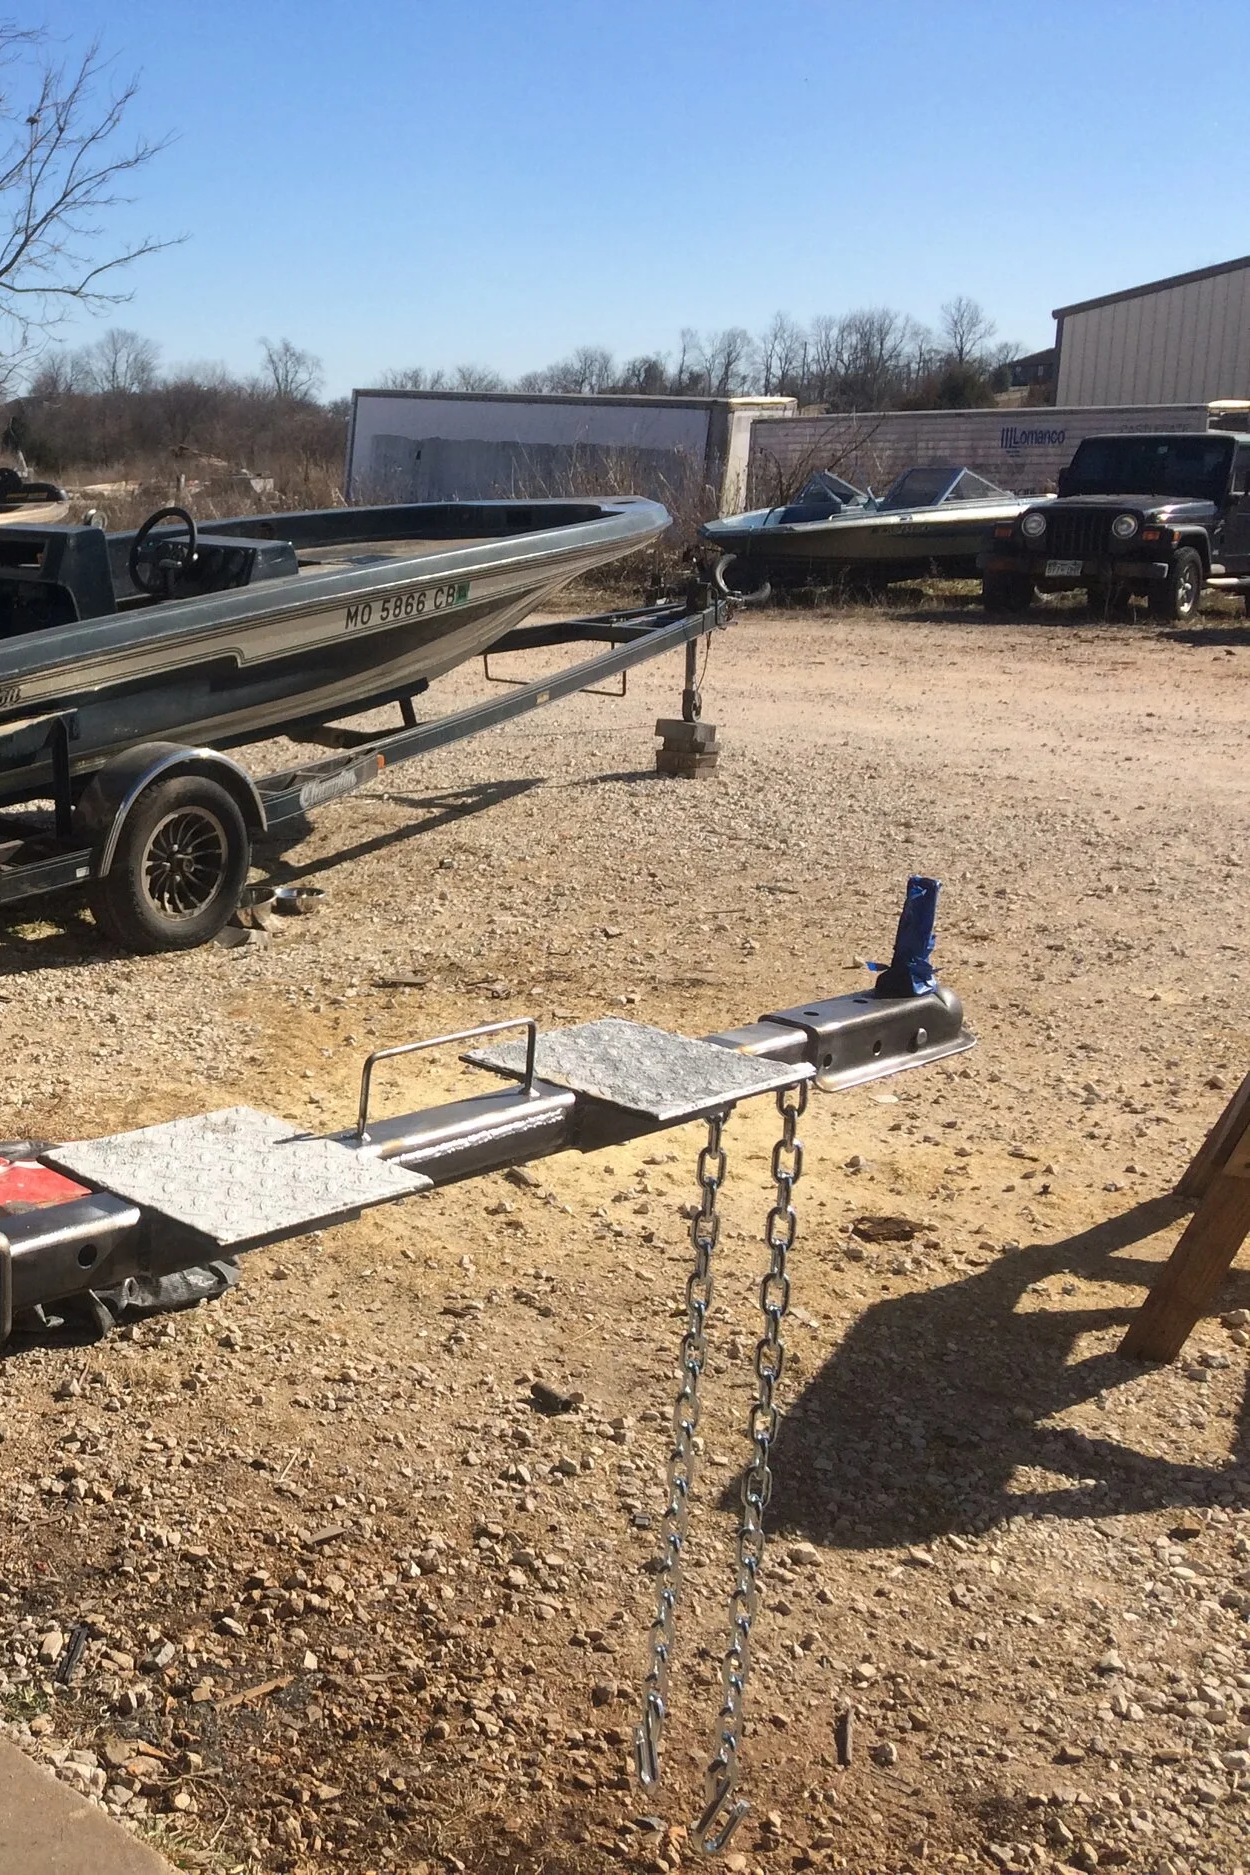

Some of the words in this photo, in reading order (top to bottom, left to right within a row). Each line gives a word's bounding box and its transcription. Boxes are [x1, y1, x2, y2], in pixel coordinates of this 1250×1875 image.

[1012, 427, 1066, 445] Lomanco
[344, 603, 372, 630] MO
[379, 591, 427, 621] 5866
[433, 584, 456, 609] CB
